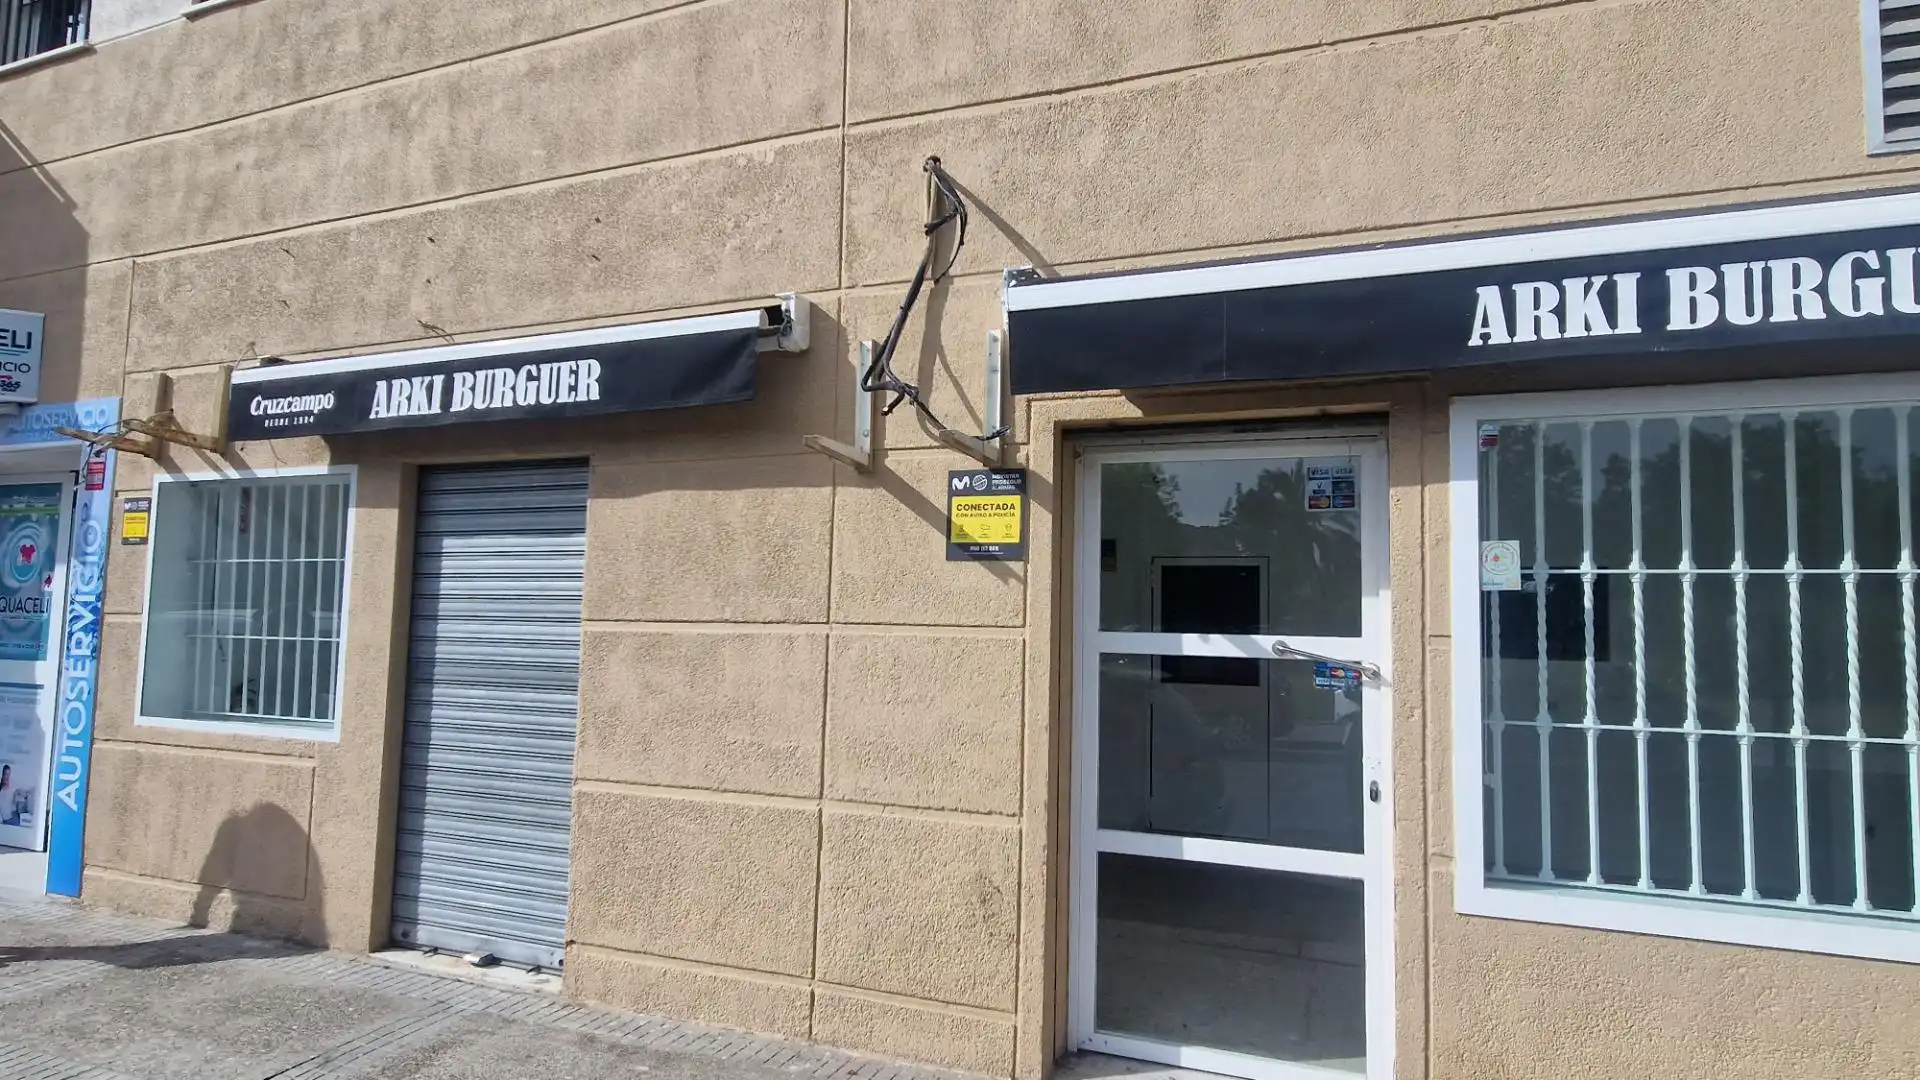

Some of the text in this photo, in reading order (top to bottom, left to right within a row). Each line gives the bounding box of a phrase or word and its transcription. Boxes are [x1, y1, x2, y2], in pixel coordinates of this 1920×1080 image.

[1468, 247, 1920, 346] ARKI BURGU
[250, 391, 335, 416] Cruzcampo
[369, 358, 601, 419] ARKI BURGUER
[956, 503, 1016, 511] CONECTADA
[57, 519, 101, 812] AUTOSERVICIO
